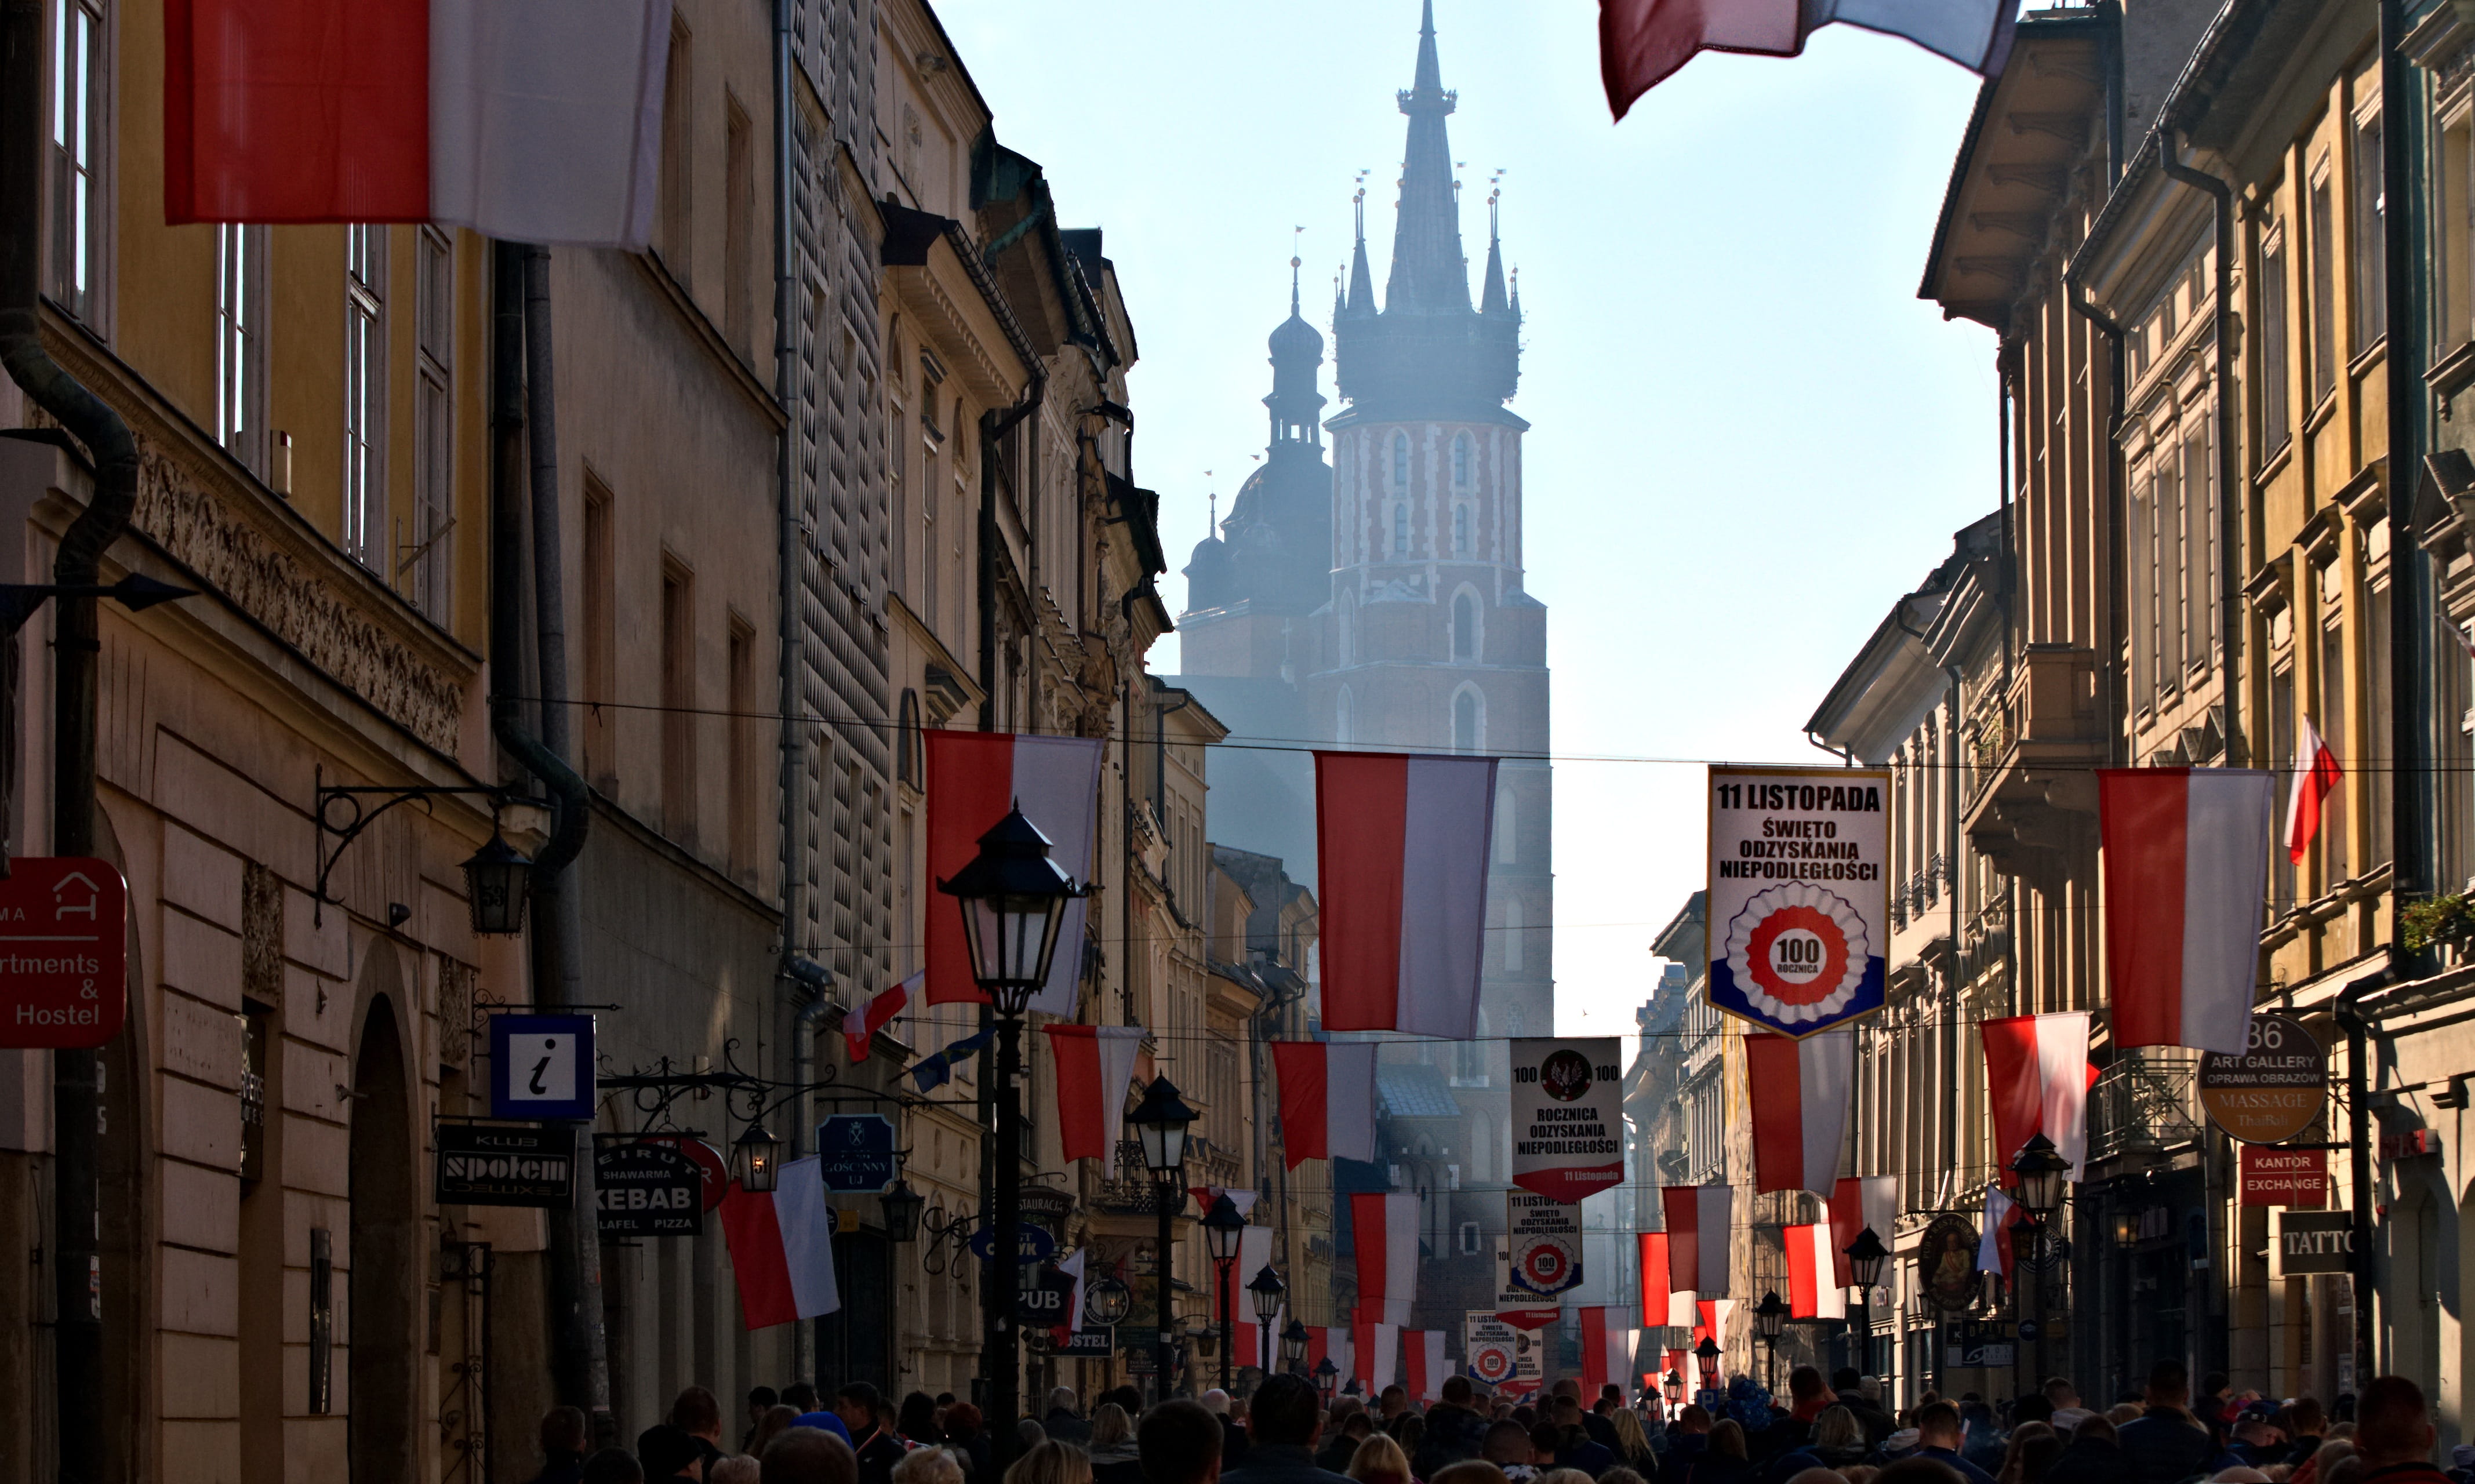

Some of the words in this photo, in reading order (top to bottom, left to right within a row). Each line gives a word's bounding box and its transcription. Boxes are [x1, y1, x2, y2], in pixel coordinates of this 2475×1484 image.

[1718, 784, 1740, 809] 11
[1748, 785, 1880, 812] LISTOPADA
[1762, 817, 1836, 841] ŚWIĘTO
[1740, 841, 1859, 859] ODZYSKANIA
[1720, 861, 1878, 881] NIEPODLEGŁOŚCI
[1777, 939, 1819, 963] 100
[1777, 964, 1818, 973] ROCZNICA
[80, 979, 99, 999] &
[16, 1004, 99, 1025] Hostel
[2211, 1056, 2242, 1068] ART
[2246, 1056, 2316, 1068] GALLERY
[1514, 1067, 1537, 1083] 100
[1596, 1065, 1618, 1081] 100
[2207, 1074, 2258, 1083] OPRAWA
[2260, 1072, 2320, 1083] OBRAZÓW
[2219, 1093, 2307, 1108] MASSAGE
[1537, 1108, 1598, 1122] ROCZNICA
[1530, 1124, 1606, 1139] ODZYSKANIA
[1518, 1138, 1618, 1155] NIEPODLEGŁOŚCI
[2255, 1156, 2311, 1169] KANTOR
[603, 1169, 672, 1180] SHAWARMA
[1565, 1172, 1573, 1181] 11
[1575, 1170, 1619, 1181] Listopada
[2247, 1179, 2321, 1190] EXCHANGE
[1511, 1196, 1521, 1206] 11
[1530, 1210, 1560, 1218] ŚWIĘTO
[654, 1219, 693, 1228] PIZZA
[1514, 1225, 1578, 1234] NIEPODLEGŁOŚCI
[1538, 1257, 1555, 1267] 100
[1702, 1391, 1714, 1410] P
